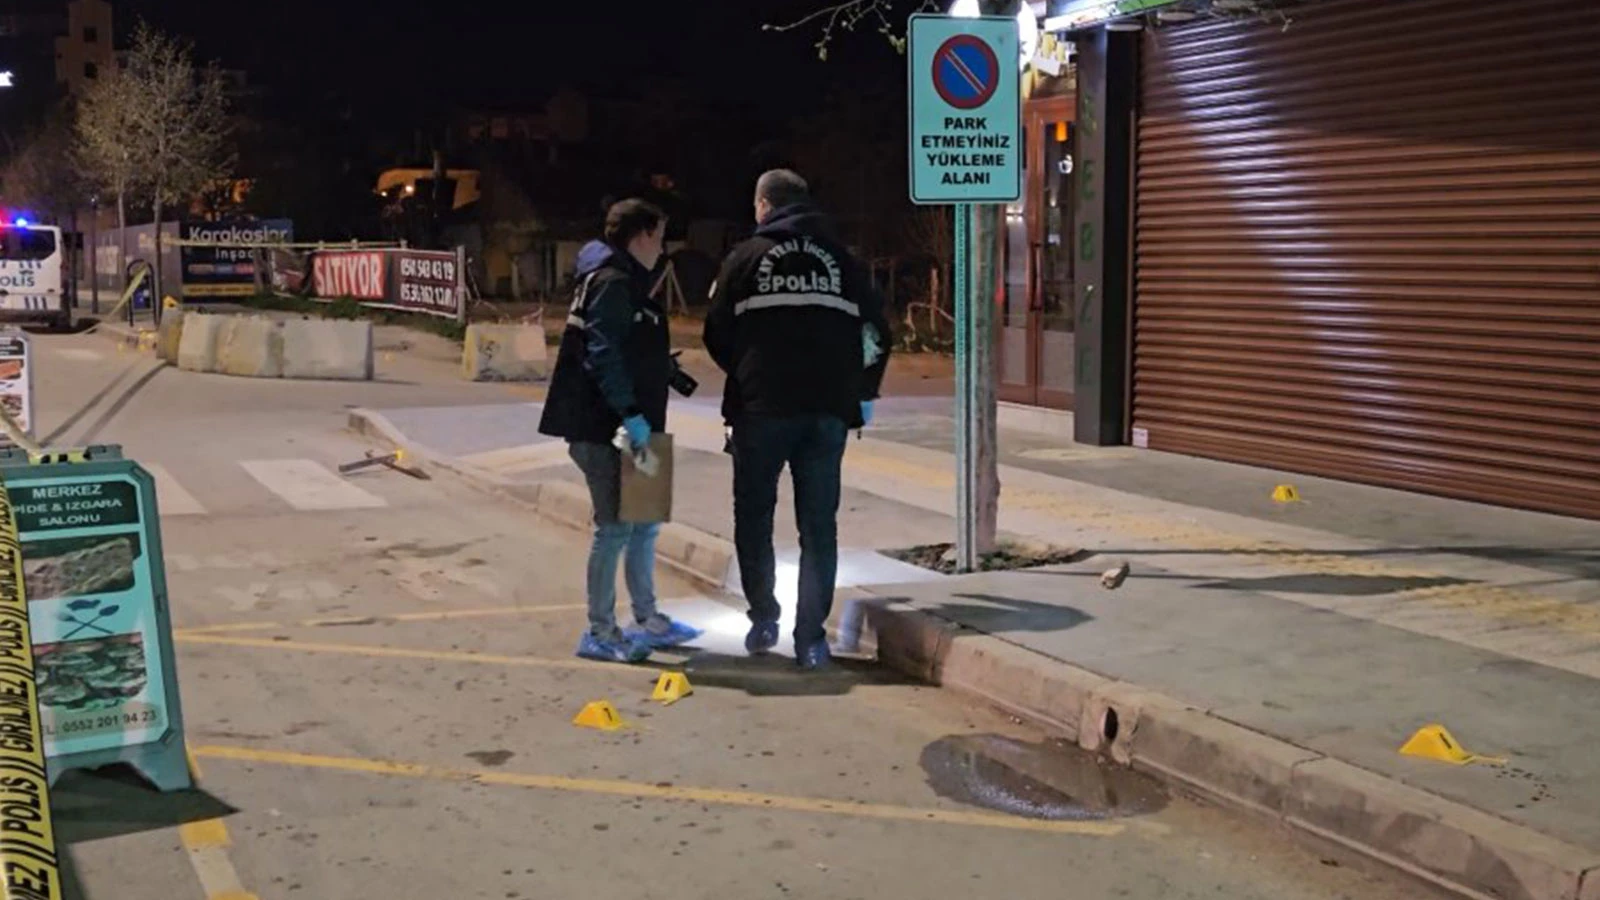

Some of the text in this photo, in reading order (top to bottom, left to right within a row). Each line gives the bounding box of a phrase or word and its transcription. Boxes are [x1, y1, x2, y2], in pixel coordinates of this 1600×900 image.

[944, 117, 987, 130] PARK
[921, 134, 1010, 149] ETMEYİNİZ
[926, 152, 1005, 167] YÜKLEME
[941, 172, 990, 185] ALANI
[0, 275, 35, 287] OLİS
[772, 270, 830, 292] POLİS
[32, 484, 103, 499] MERKEZ
[51, 503, 63, 512] &
[66, 498, 123, 511] IZGARA
[40, 514, 101, 527] SALONU
